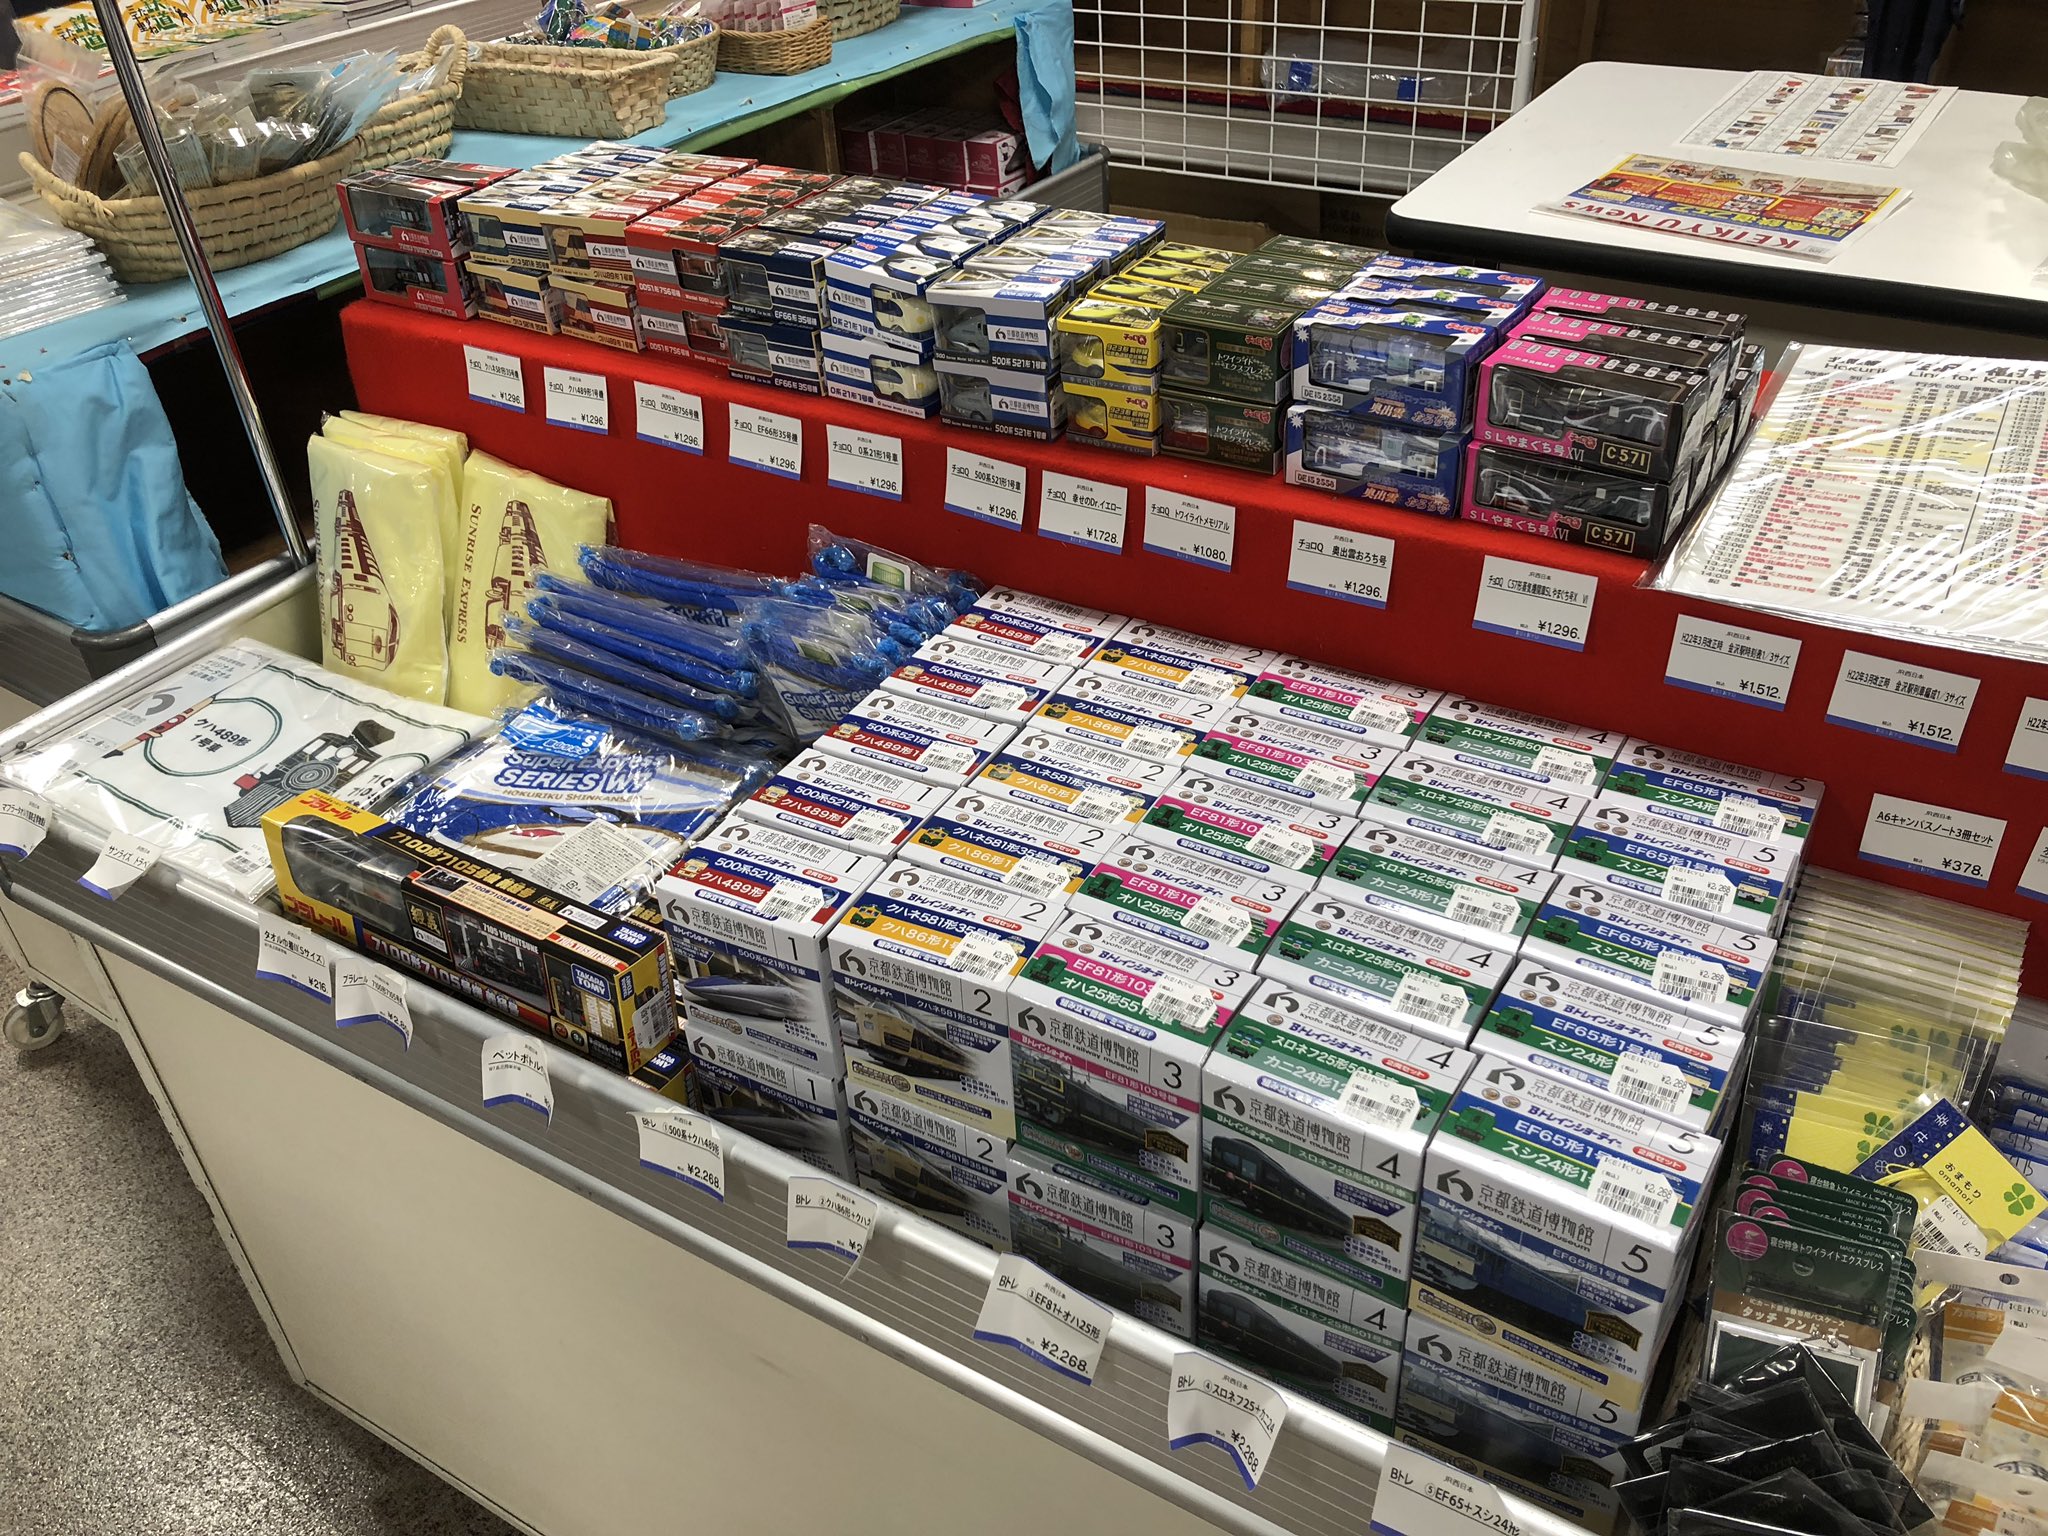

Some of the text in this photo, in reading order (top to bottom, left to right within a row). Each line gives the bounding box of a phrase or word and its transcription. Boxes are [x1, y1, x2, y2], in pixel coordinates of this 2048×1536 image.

[1652, 213, 1799, 250] KEIKYU
[1174, 509, 1230, 533] トワイライトメモリアル
[1298, 538, 1387, 568] チョロQ 奥出雲おろち号
[456, 502, 482, 644] SUNRISE EXPRESS
[190, 733, 226, 754] 1号車
[194, 717, 252, 748] クハ489形
[502, 788, 564, 801] HOKURIKU
[108, 845, 132, 863] サンライズ
[613, 930, 645, 946] TOMY
[690, 907, 767, 946] 京都鉄道博物館
[738, 948, 807, 976] 500系521形1号車
[787, 937, 799, 961] 1
[575, 968, 605, 987] TAKARA
[576, 977, 606, 996] TOMY
[867, 957, 952, 997] 京都鉄道博物館
[915, 999, 997, 1033] クハネ581形35号車
[973, 988, 993, 1017] 2
[1303, 1001, 1407, 1046] 京都鉄道博物館
[1050, 1017, 1140, 1068] 京都鉄道博物館
[716, 1044, 787, 1088] 京都鉄道博物館
[1163, 1061, 1183, 1089] 3
[1105, 1069, 1178, 1104] EF81形103号機
[879, 1098, 957, 1144] 京都鉄道博物館
[1532, 1078, 1645, 1132] 京都鉄道博物館
[1249, 1098, 1351, 1151] 京都鉄道博物館
[1275, 1123, 1308, 1143] railway
[1309, 1138, 1350, 1160] museum
[1375, 1153, 1401, 1180] 4
[1944, 1160, 1983, 1201] おまもり
[1937, 1168, 1976, 1206] omamori
[1046, 1183, 1134, 1230] 京都鉄道博物館
[1479, 1182, 1595, 1247] 京都鉄道博物館
[1156, 1223, 1176, 1249] 3
[1477, 1201, 1591, 1252] kyoto railway museum
[1552, 1248, 1630, 1287] EF65形1号機
[1620, 1244, 1653, 1273] 5
[1769, 1236, 1885, 1272] 寝台特急トワイライトエクスプレス
[998, 1275, 1018, 1289] Bトレ
[1243, 1257, 1340, 1309] 京都鉄道博物館
[1363, 1308, 1388, 1331] 4
[1742, 1306, 1779, 1324] タッチ
[1178, 1375, 1196, 1388] Bトレ
[1456, 1346, 1567, 1401] 京都鉄道博物館
[1593, 1399, 1622, 1424] 5
[1390, 1467, 1414, 1485] Bトレ
